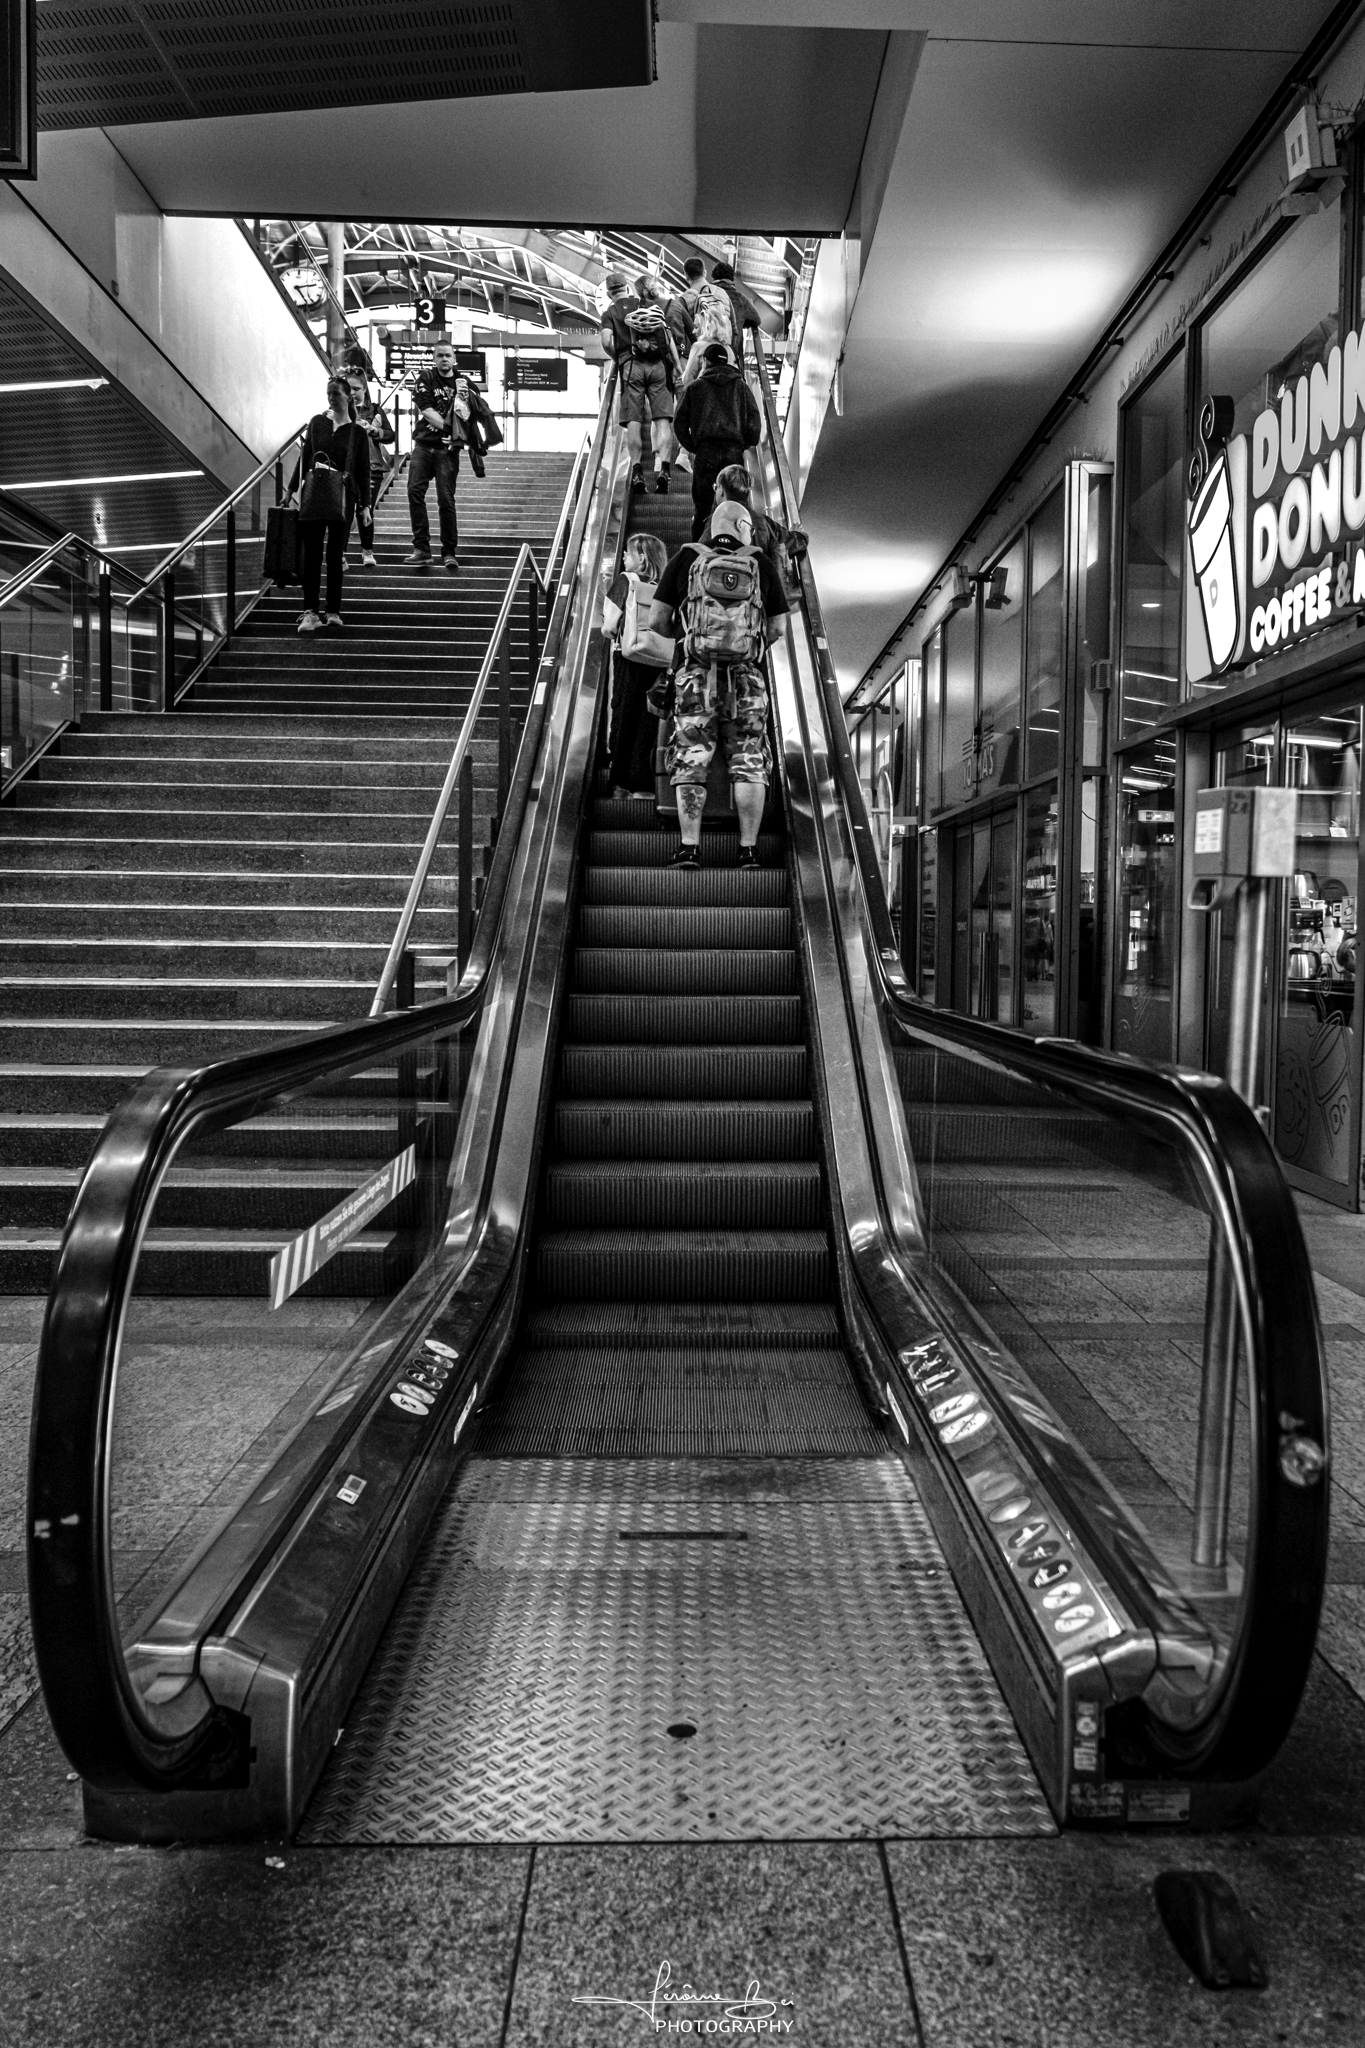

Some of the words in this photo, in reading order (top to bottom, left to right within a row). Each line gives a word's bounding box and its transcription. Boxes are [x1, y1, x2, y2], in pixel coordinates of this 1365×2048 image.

[418, 299, 434, 324] 3
[1250, 566, 1332, 653] COFFEE
[1334, 561, 1351, 608] &
